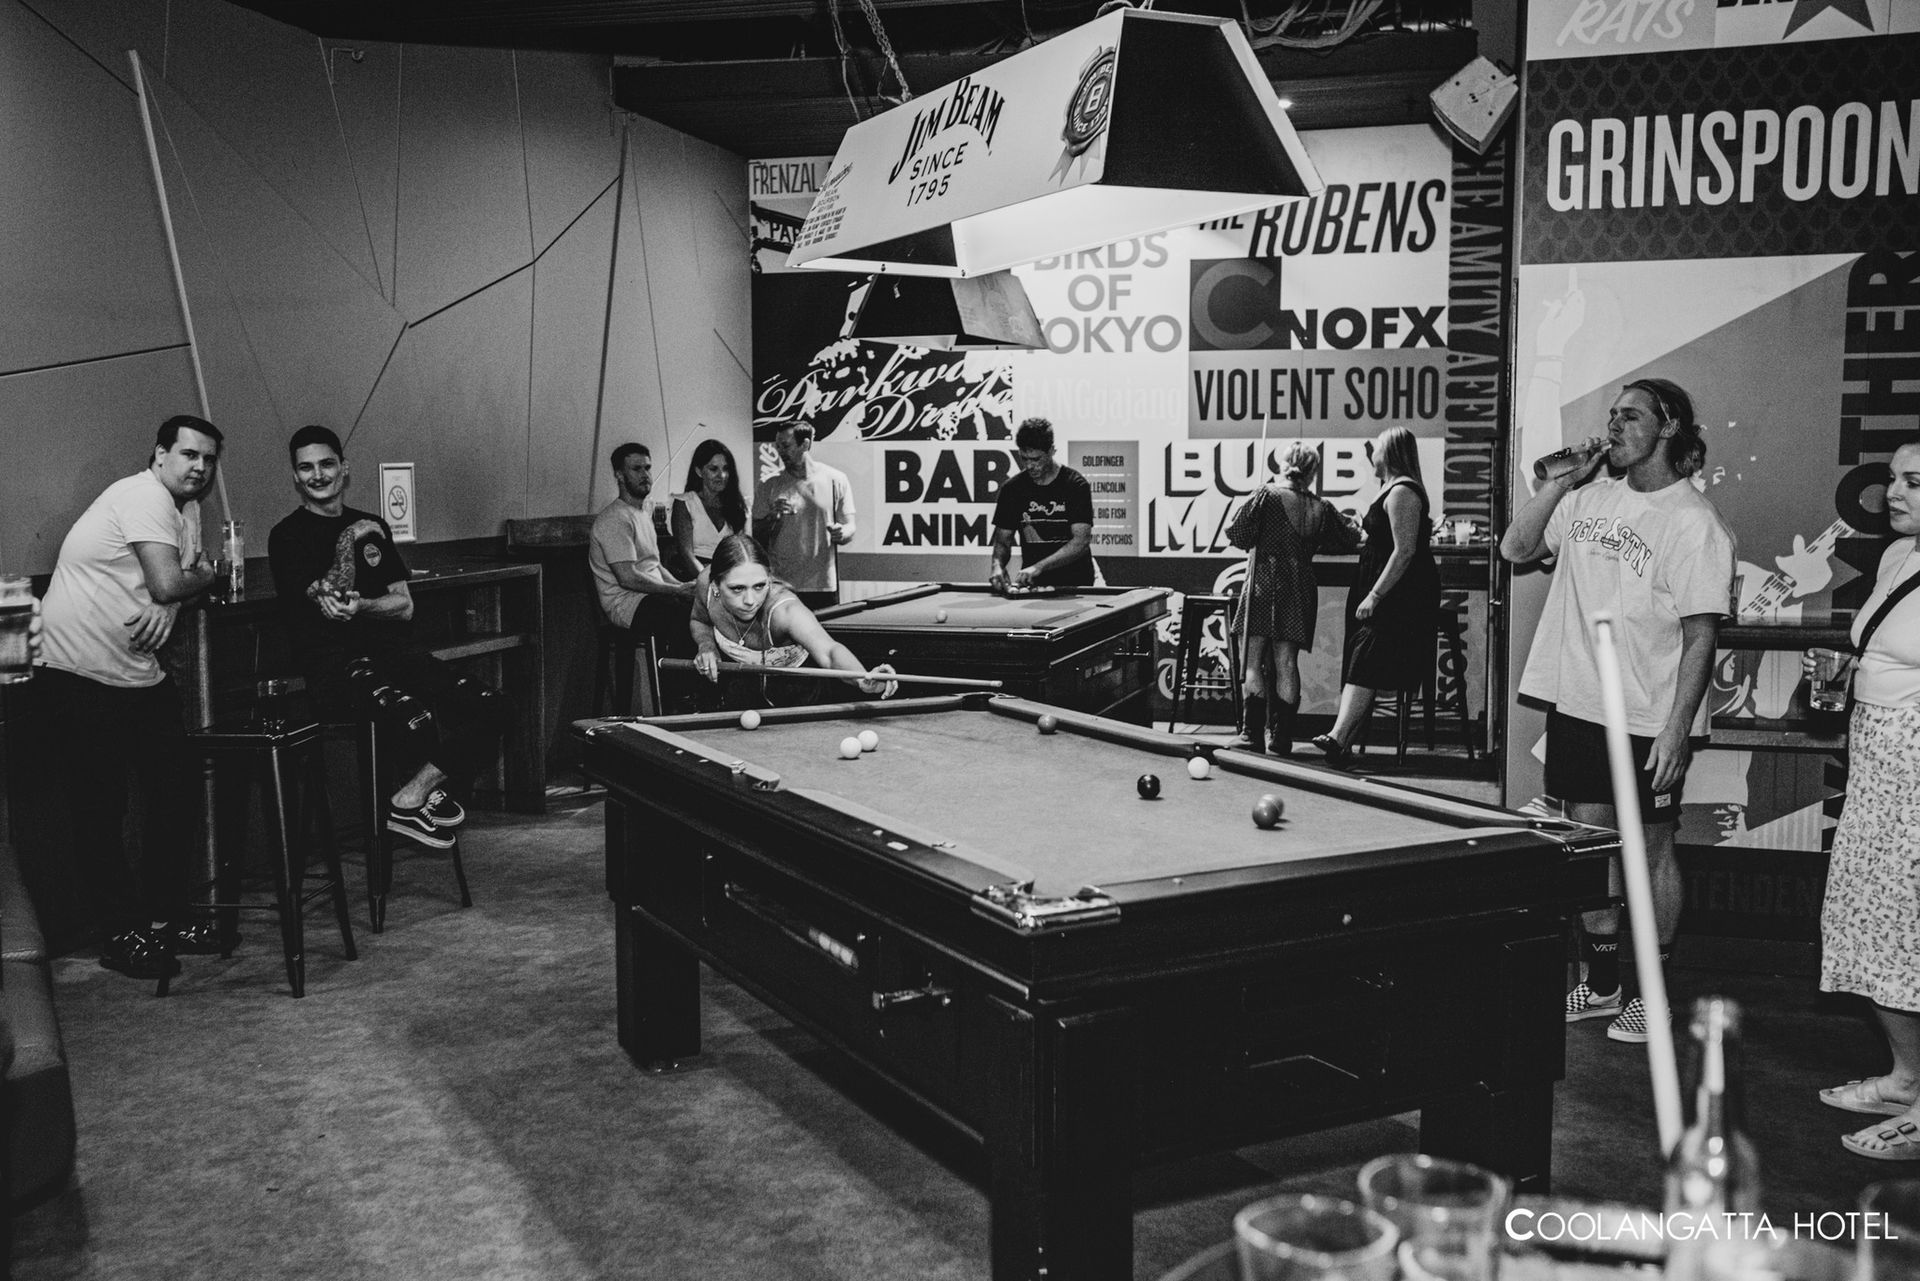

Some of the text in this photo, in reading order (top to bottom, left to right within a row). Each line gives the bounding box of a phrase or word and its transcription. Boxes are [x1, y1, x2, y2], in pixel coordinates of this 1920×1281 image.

[888, 76, 1006, 185] JIM BEAM
[910, 141, 969, 181] SINCE
[1451, 140, 1505, 208] HE
[1547, 100, 1920, 212] GRINSPOON
[753, 162, 821, 195] FRENZAL
[907, 174, 951, 207] 1795
[1248, 178, 1447, 258] RUBENS
[1067, 273, 1133, 313] OF
[1448, 221, 1503, 338] AMITY
[1027, 314, 1183, 355] OKYO
[1283, 306, 1448, 350] NOFX
[1194, 365, 1440, 421] VIOLENT SOHO
[1444, 350, 1500, 526] AFFLICTI
[885, 449, 1024, 504] BAB
[1082, 455, 1124, 467] GOLDFINGER
[1090, 481, 1126, 494] LLENCOLIN
[1102, 534, 1133, 546] PSYCHOS
